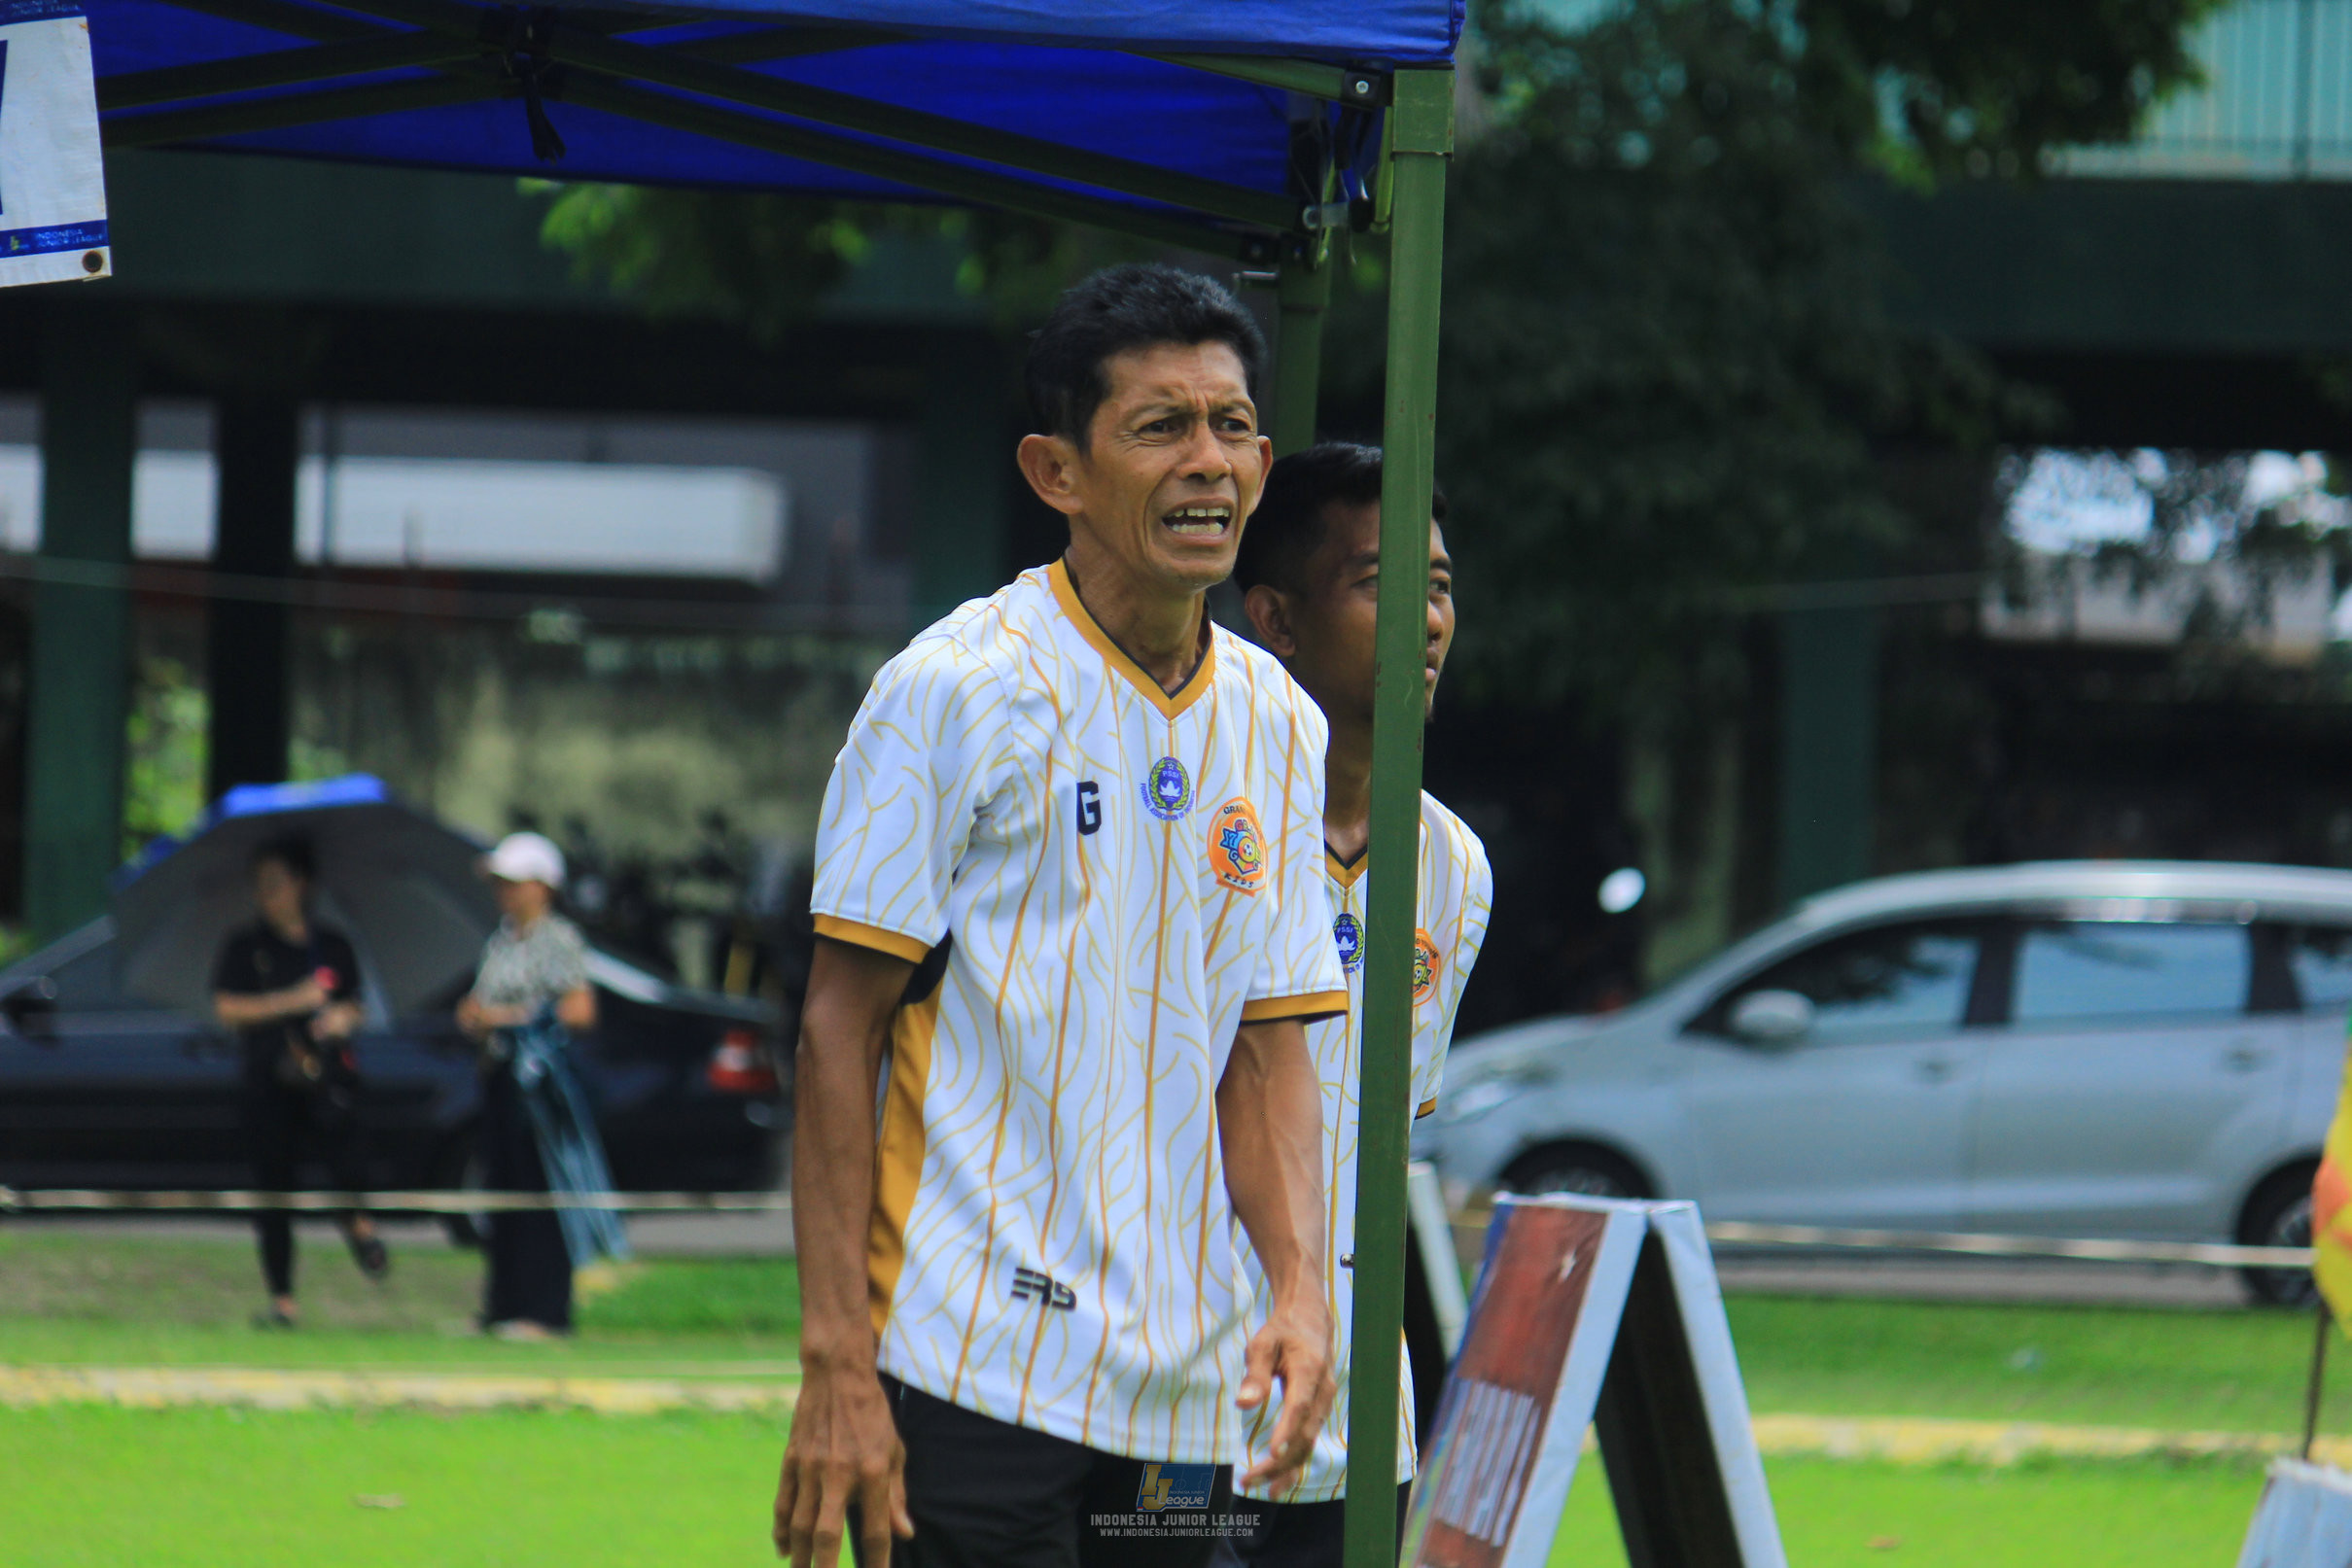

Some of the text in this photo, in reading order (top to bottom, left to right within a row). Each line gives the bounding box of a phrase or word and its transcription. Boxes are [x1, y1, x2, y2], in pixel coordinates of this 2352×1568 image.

[1162, 770, 1180, 779] PSSI
[1076, 781, 1103, 836] G
[1224, 872, 1254, 889] KIDS
